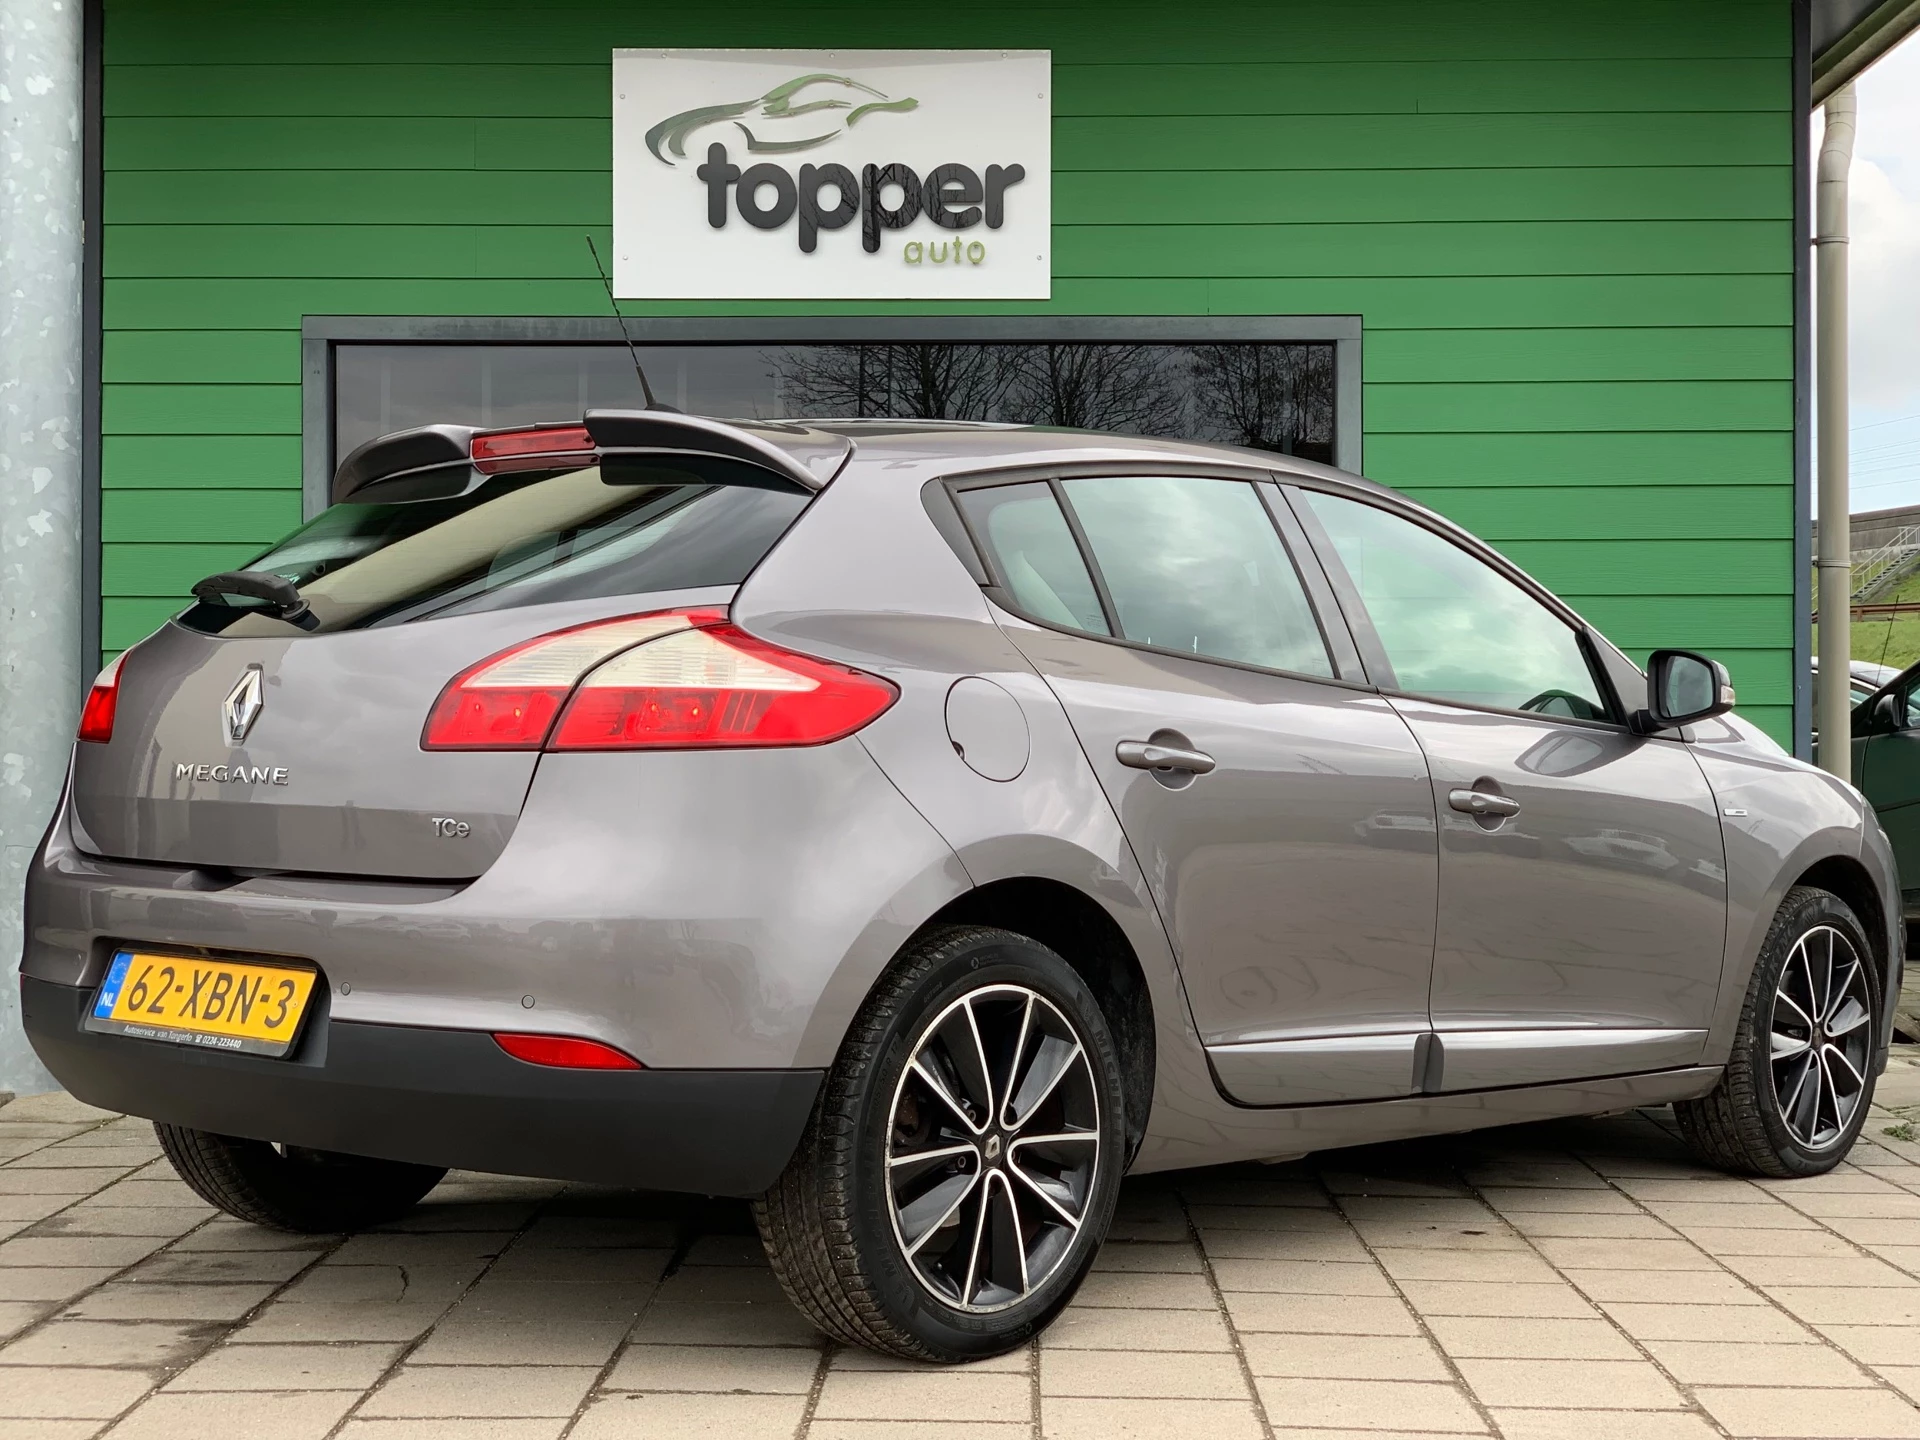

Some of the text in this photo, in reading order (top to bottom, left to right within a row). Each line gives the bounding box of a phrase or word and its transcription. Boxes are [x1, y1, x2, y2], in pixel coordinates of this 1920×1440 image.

[697, 142, 1025, 253] topper
[904, 236, 986, 264] auto
[176, 763, 289, 786] MEGANE
[432, 817, 471, 838] TCe
[101, 992, 113, 1007] NL
[128, 965, 295, 1028] 62-XBN-3
[123, 1025, 156, 1037] Autoservice
[202, 1035, 242, 1049] 0224-223440
